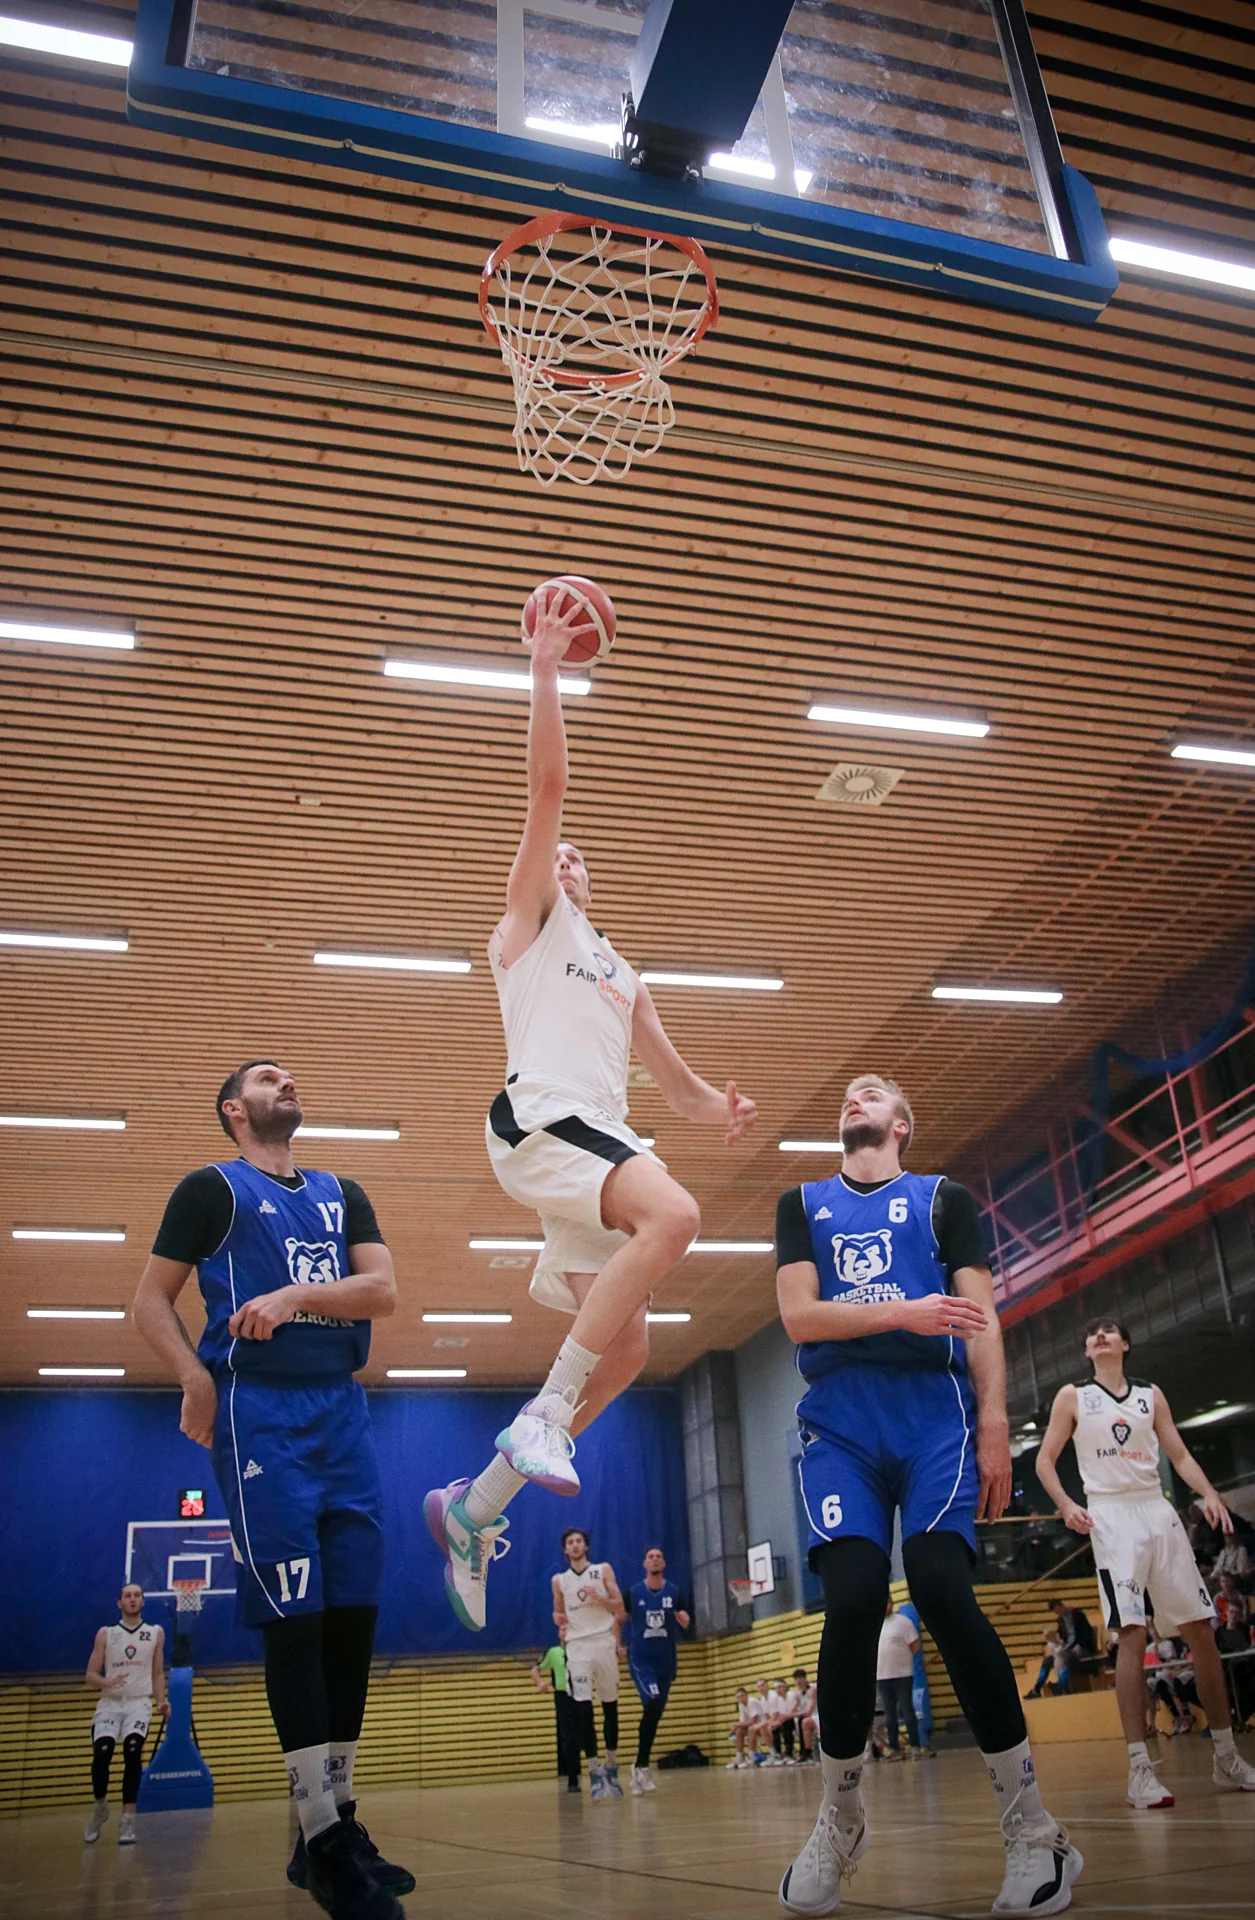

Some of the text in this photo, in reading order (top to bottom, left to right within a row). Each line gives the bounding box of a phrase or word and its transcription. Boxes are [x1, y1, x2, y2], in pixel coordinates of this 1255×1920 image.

[566, 963, 632, 1011] FAIR SPORT
[317, 1201, 344, 1234] 17
[888, 1197, 908, 1223] 6
[832, 1283, 902, 1303] BASKETBAL
[1137, 1398, 1149, 1414] 3
[1096, 1448, 1118, 1459] FAIR
[821, 1494, 843, 1529] 6
[276, 1557, 310, 1603] 17
[589, 1570, 601, 1580] 12
[1199, 1587, 1211, 1607] 3
[139, 1631, 152, 1641] 22
[133, 1720, 146, 1732] 22
